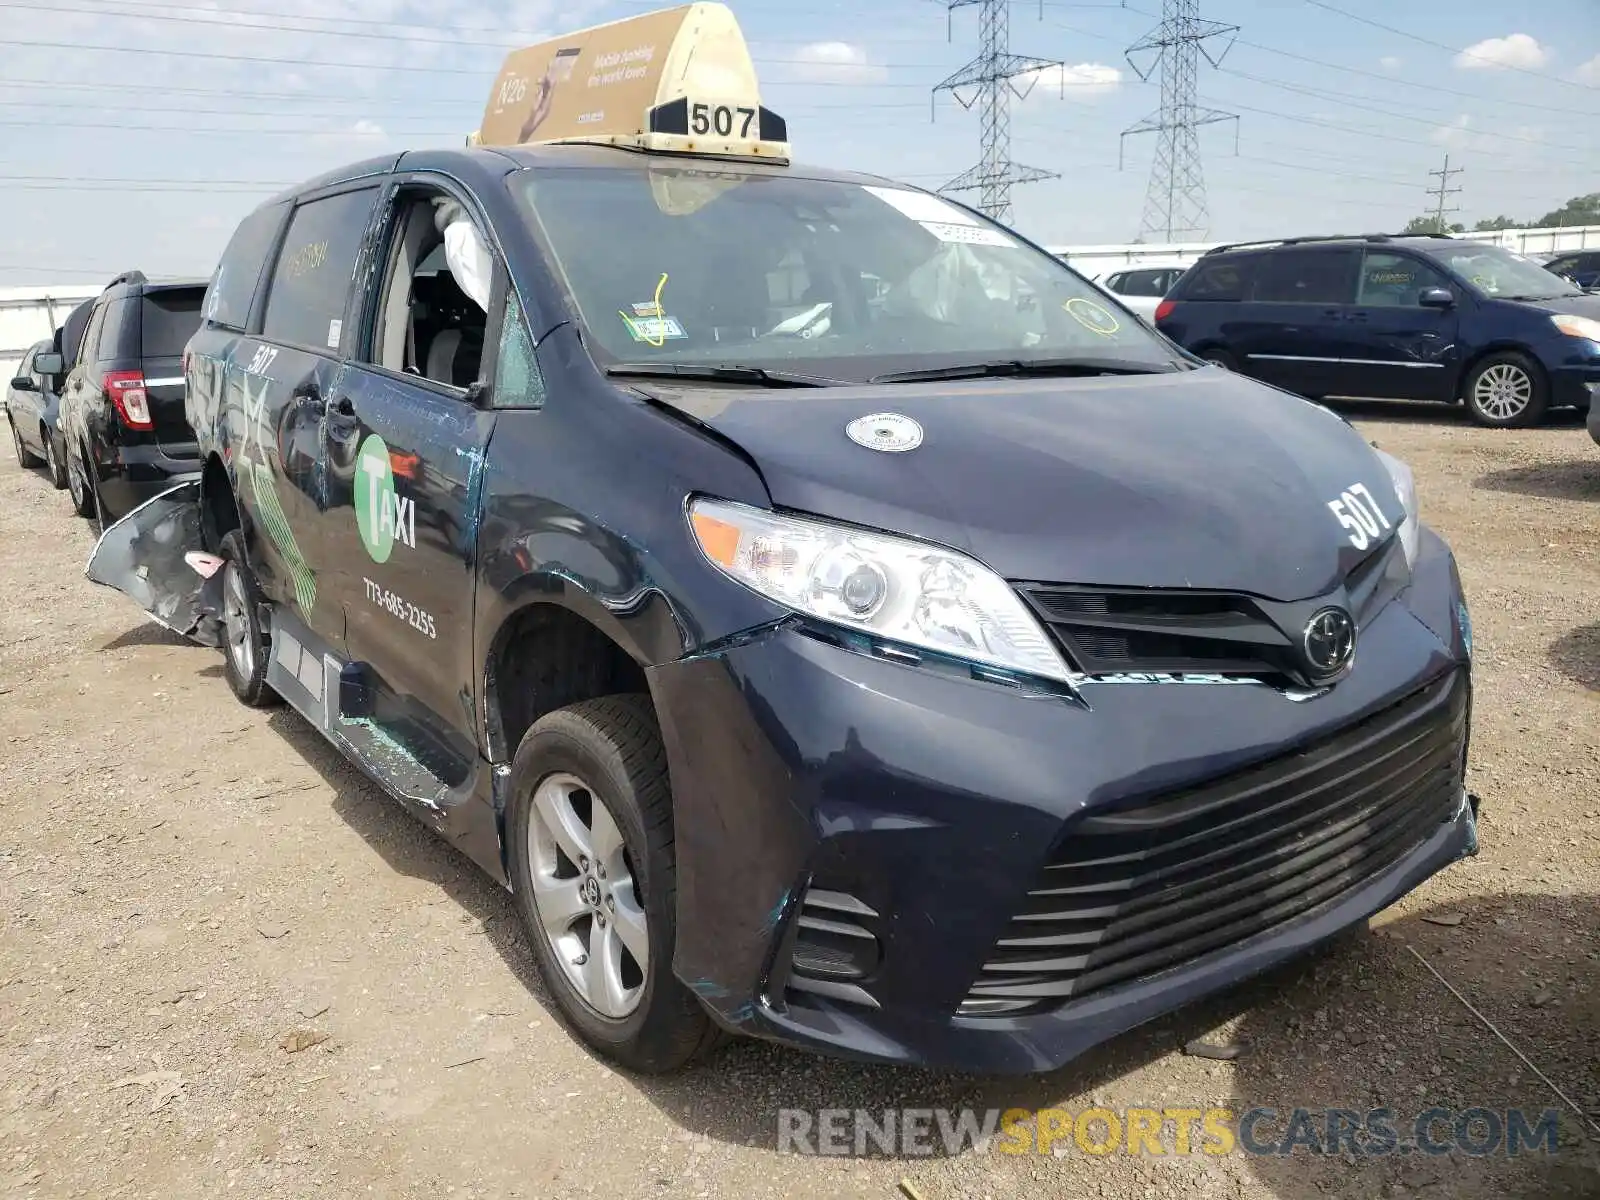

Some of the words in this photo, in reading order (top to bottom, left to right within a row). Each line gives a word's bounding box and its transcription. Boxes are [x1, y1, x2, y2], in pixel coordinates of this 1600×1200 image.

[691, 103, 756, 137] 507
[248, 345, 279, 374] 507
[363, 453, 416, 549] TAXI
[1327, 482, 1391, 550] 507
[363, 577, 437, 639] 773-685-2255
